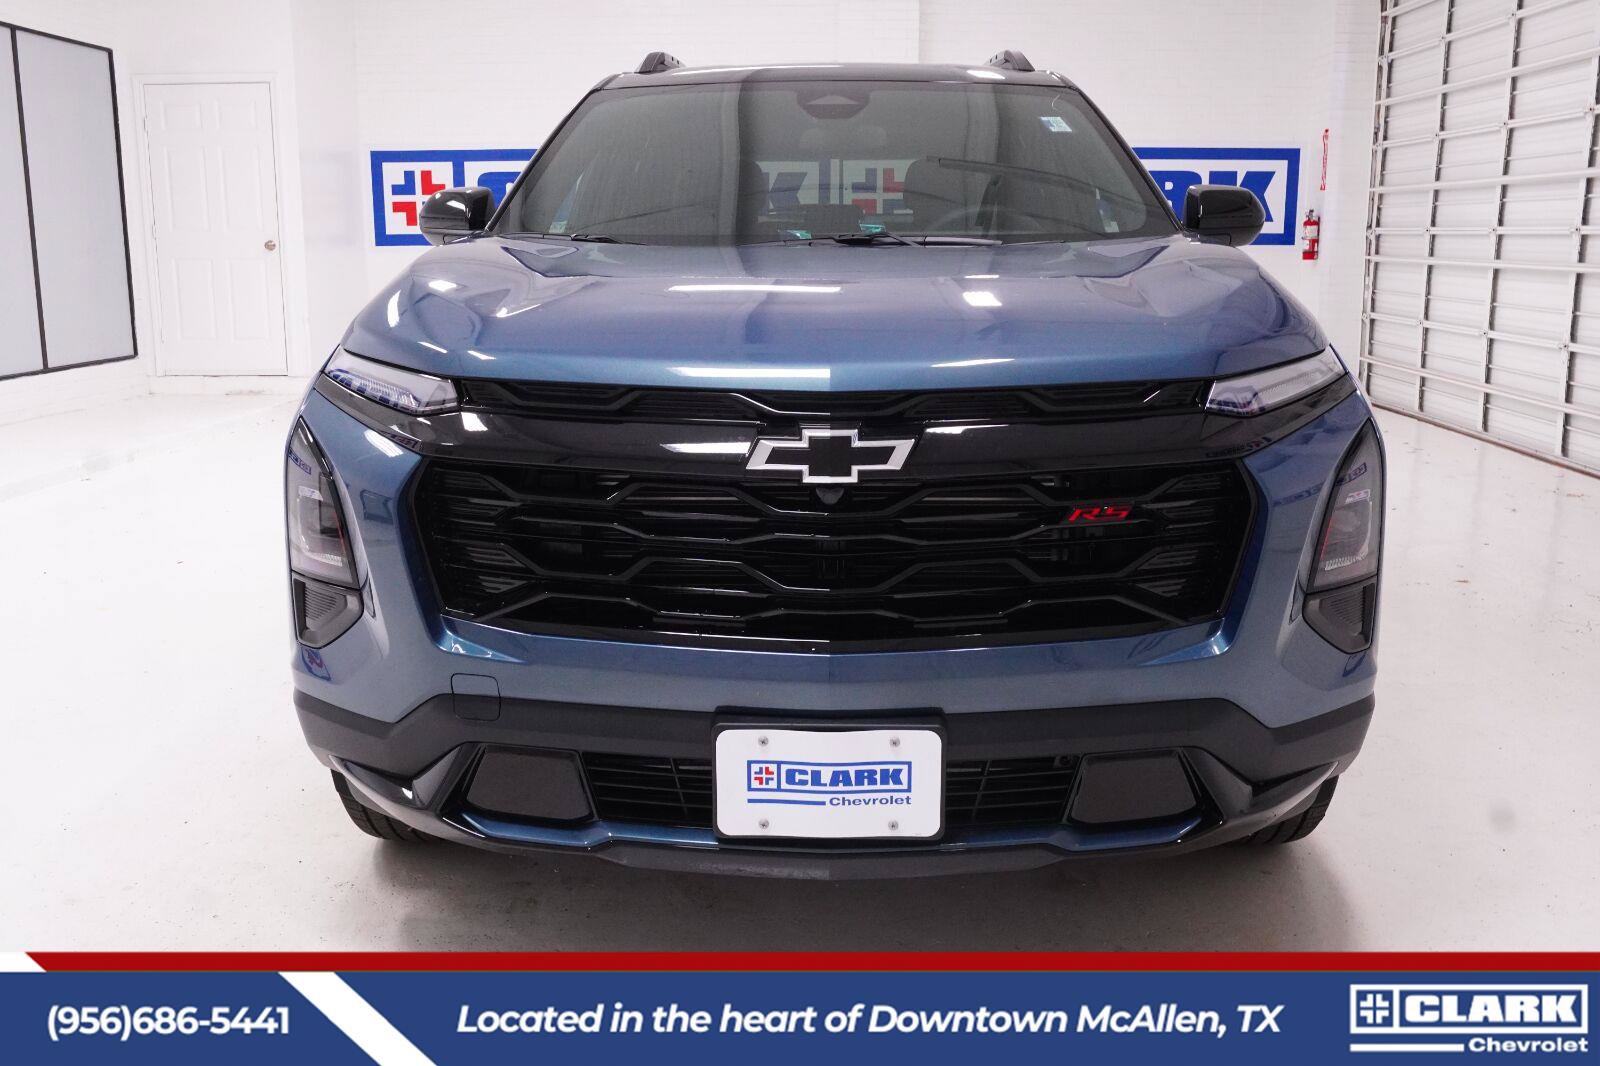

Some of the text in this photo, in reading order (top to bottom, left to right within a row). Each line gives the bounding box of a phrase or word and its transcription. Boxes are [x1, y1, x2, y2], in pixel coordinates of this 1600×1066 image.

[1067, 503, 1132, 523] RS
[785, 768, 904, 787] CLARK
[828, 795, 912, 807] Chevrolet
